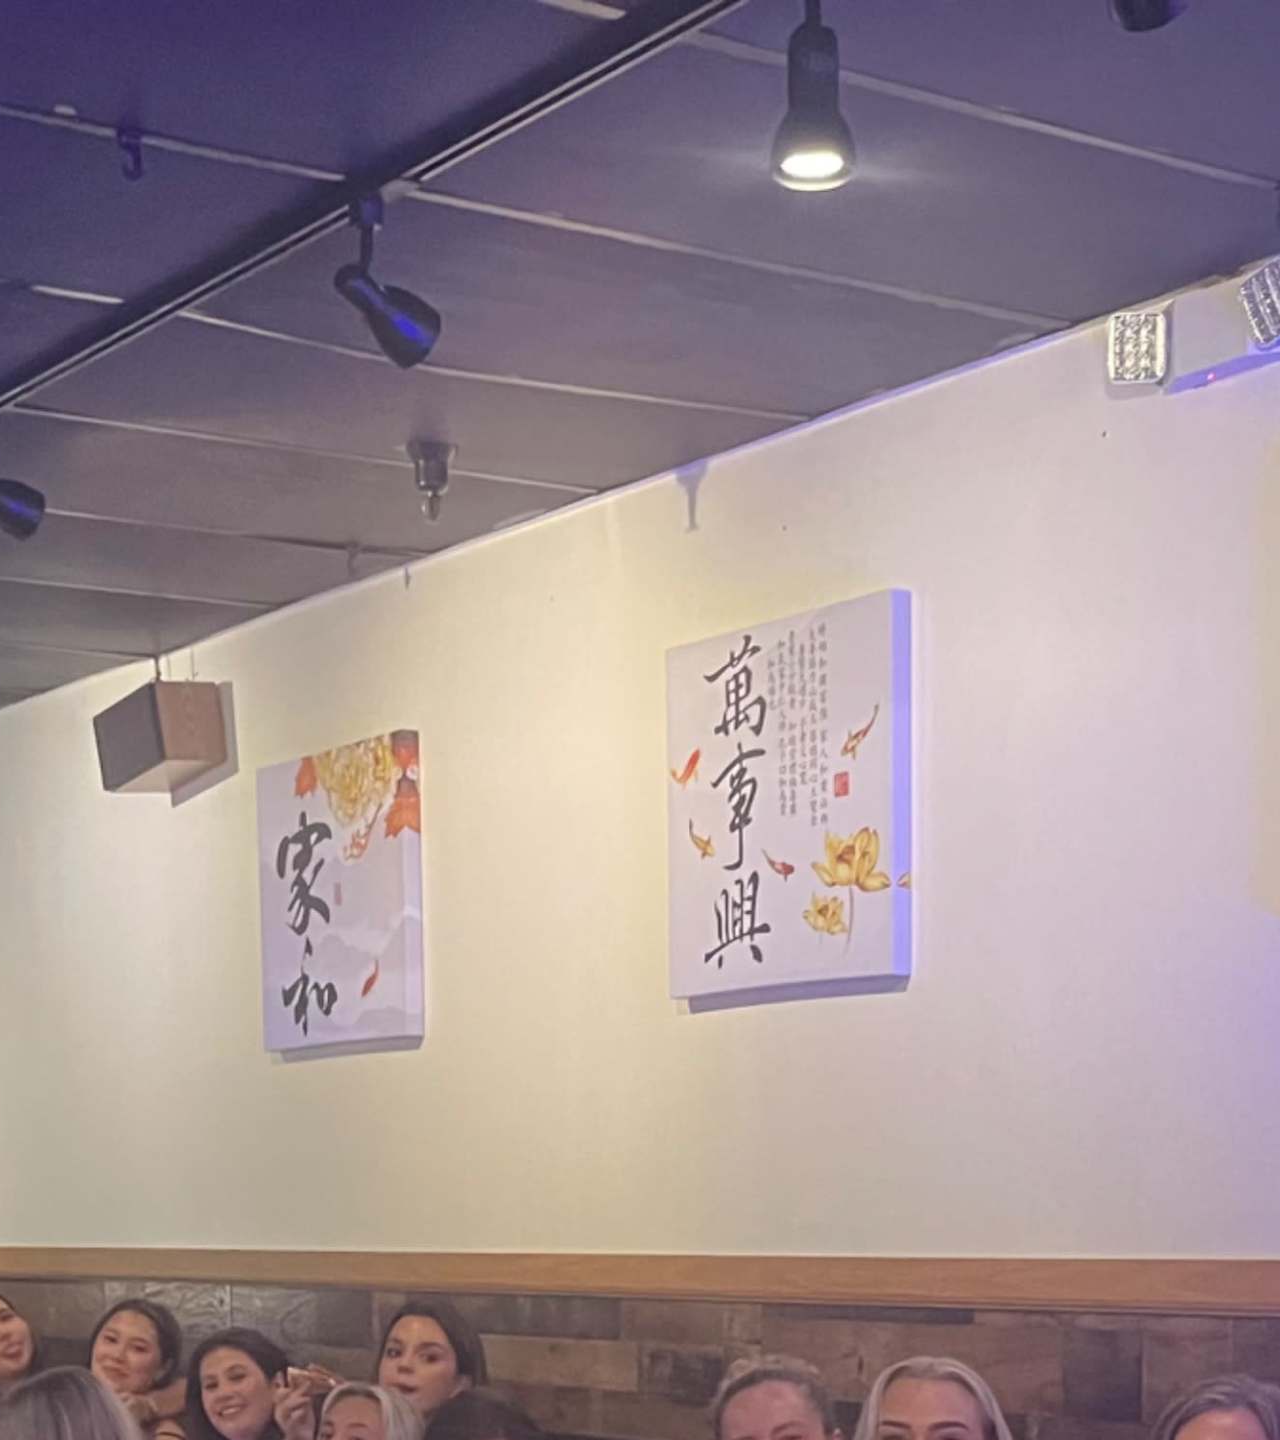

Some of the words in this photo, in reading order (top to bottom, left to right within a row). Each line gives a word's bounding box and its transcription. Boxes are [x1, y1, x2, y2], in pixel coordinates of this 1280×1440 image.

[276, 810, 338, 1037] 家和
[703, 634, 771, 970] 萬事興
